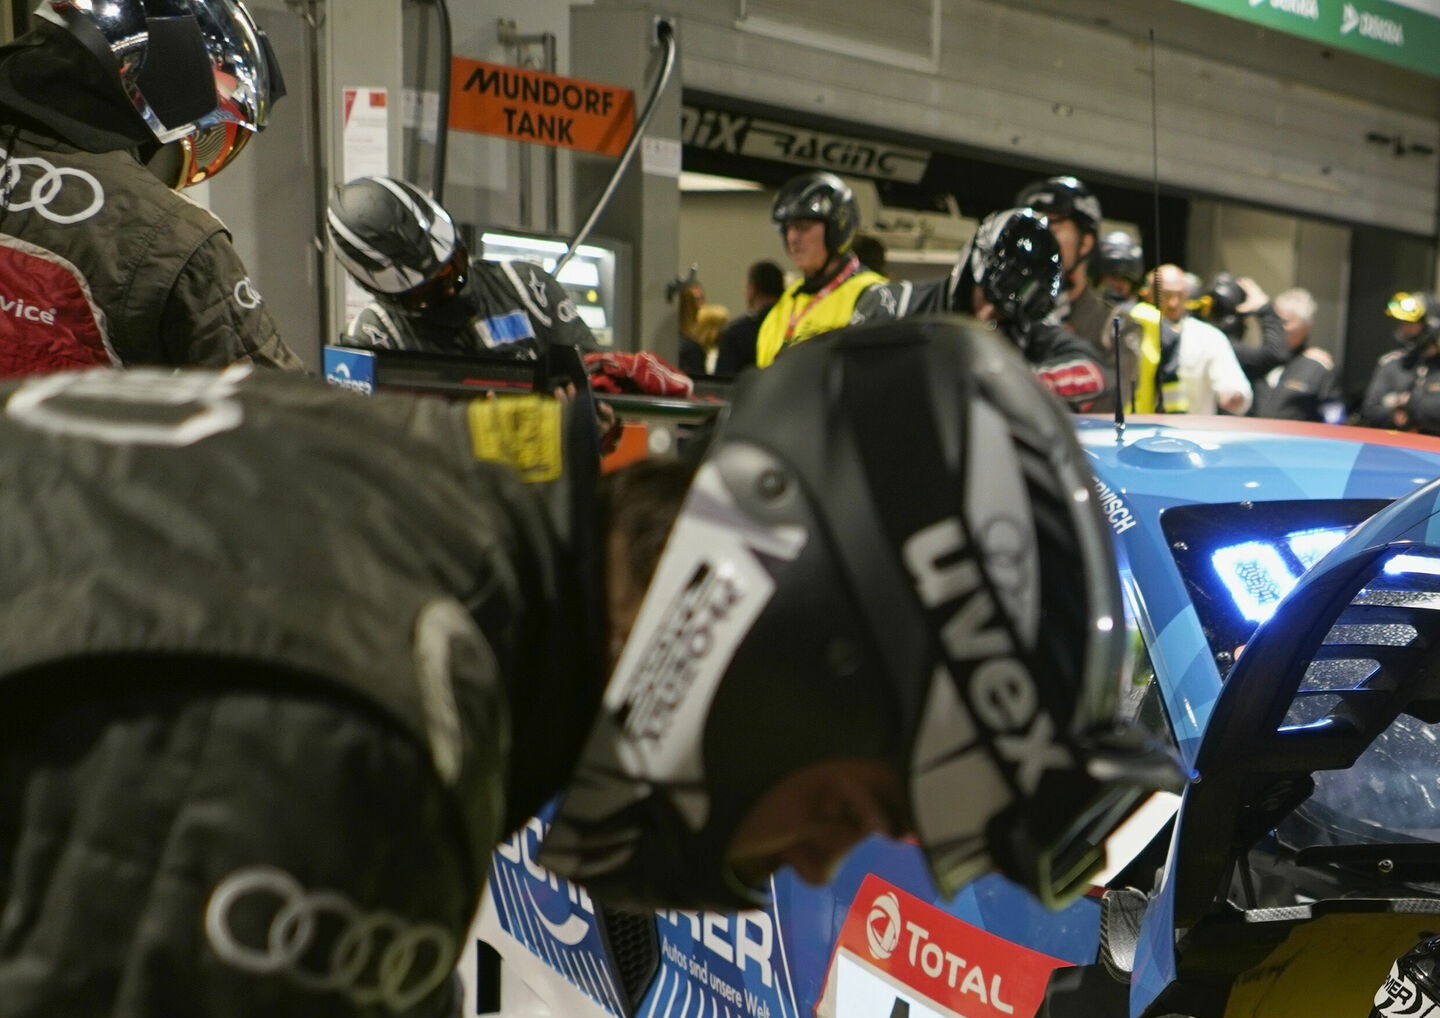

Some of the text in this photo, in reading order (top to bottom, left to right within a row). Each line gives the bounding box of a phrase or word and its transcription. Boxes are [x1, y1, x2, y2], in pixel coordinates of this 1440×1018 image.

[463, 67, 614, 116] MUNDORF
[504, 107, 573, 145] TANK
[902, 515, 1075, 797] uvex
[661, 935, 688, 971] Autos
[689, 956, 709, 986] sind
[709, 974, 743, 1008] unsere
[906, 920, 1014, 1015] TOTAL
